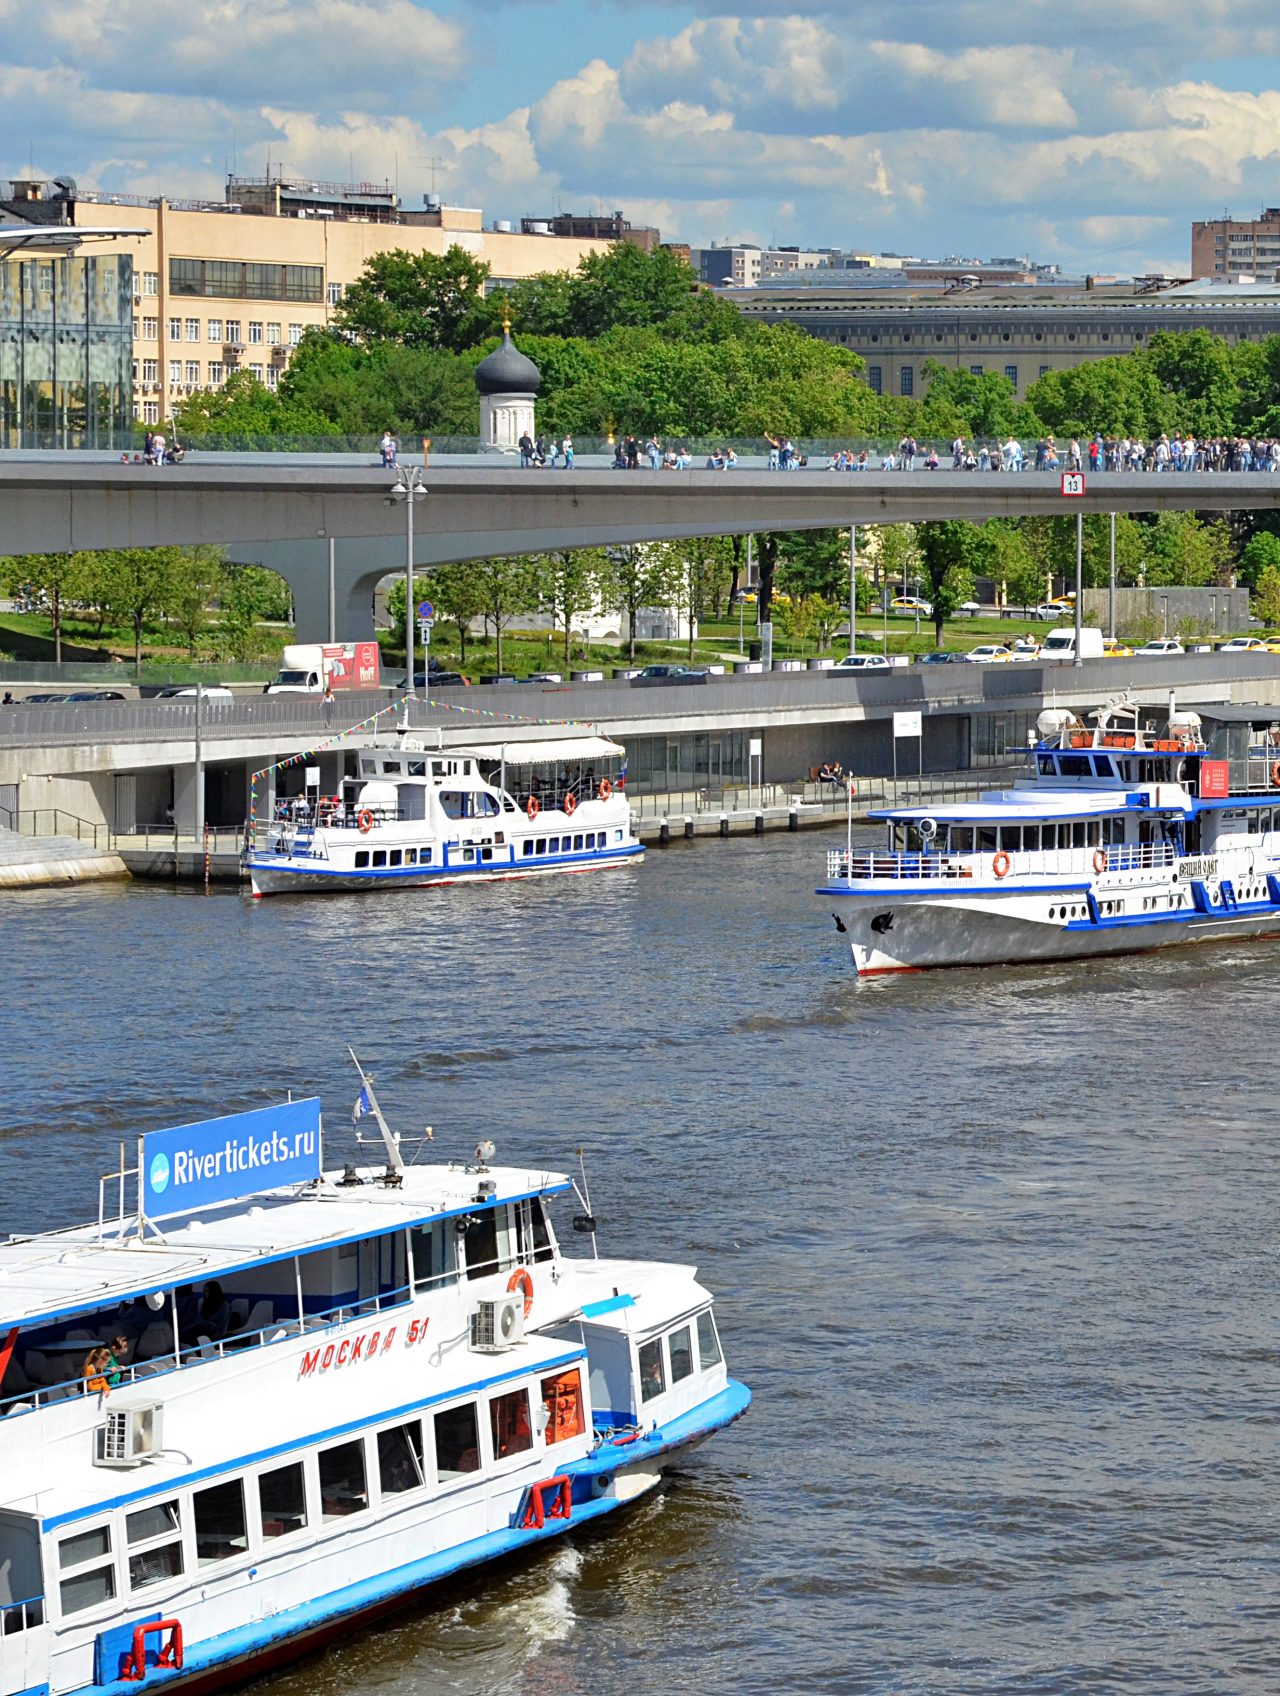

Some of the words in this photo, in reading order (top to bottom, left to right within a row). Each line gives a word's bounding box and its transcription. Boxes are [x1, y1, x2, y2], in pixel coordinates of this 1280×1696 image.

[1068, 480, 1079, 492] 13
[360, 666, 375, 682] Hoff
[174, 1130, 315, 1186] Rivertickets.ru
[300, 1326, 398, 1377] МОСКВА
[407, 1316, 430, 1344] 51
